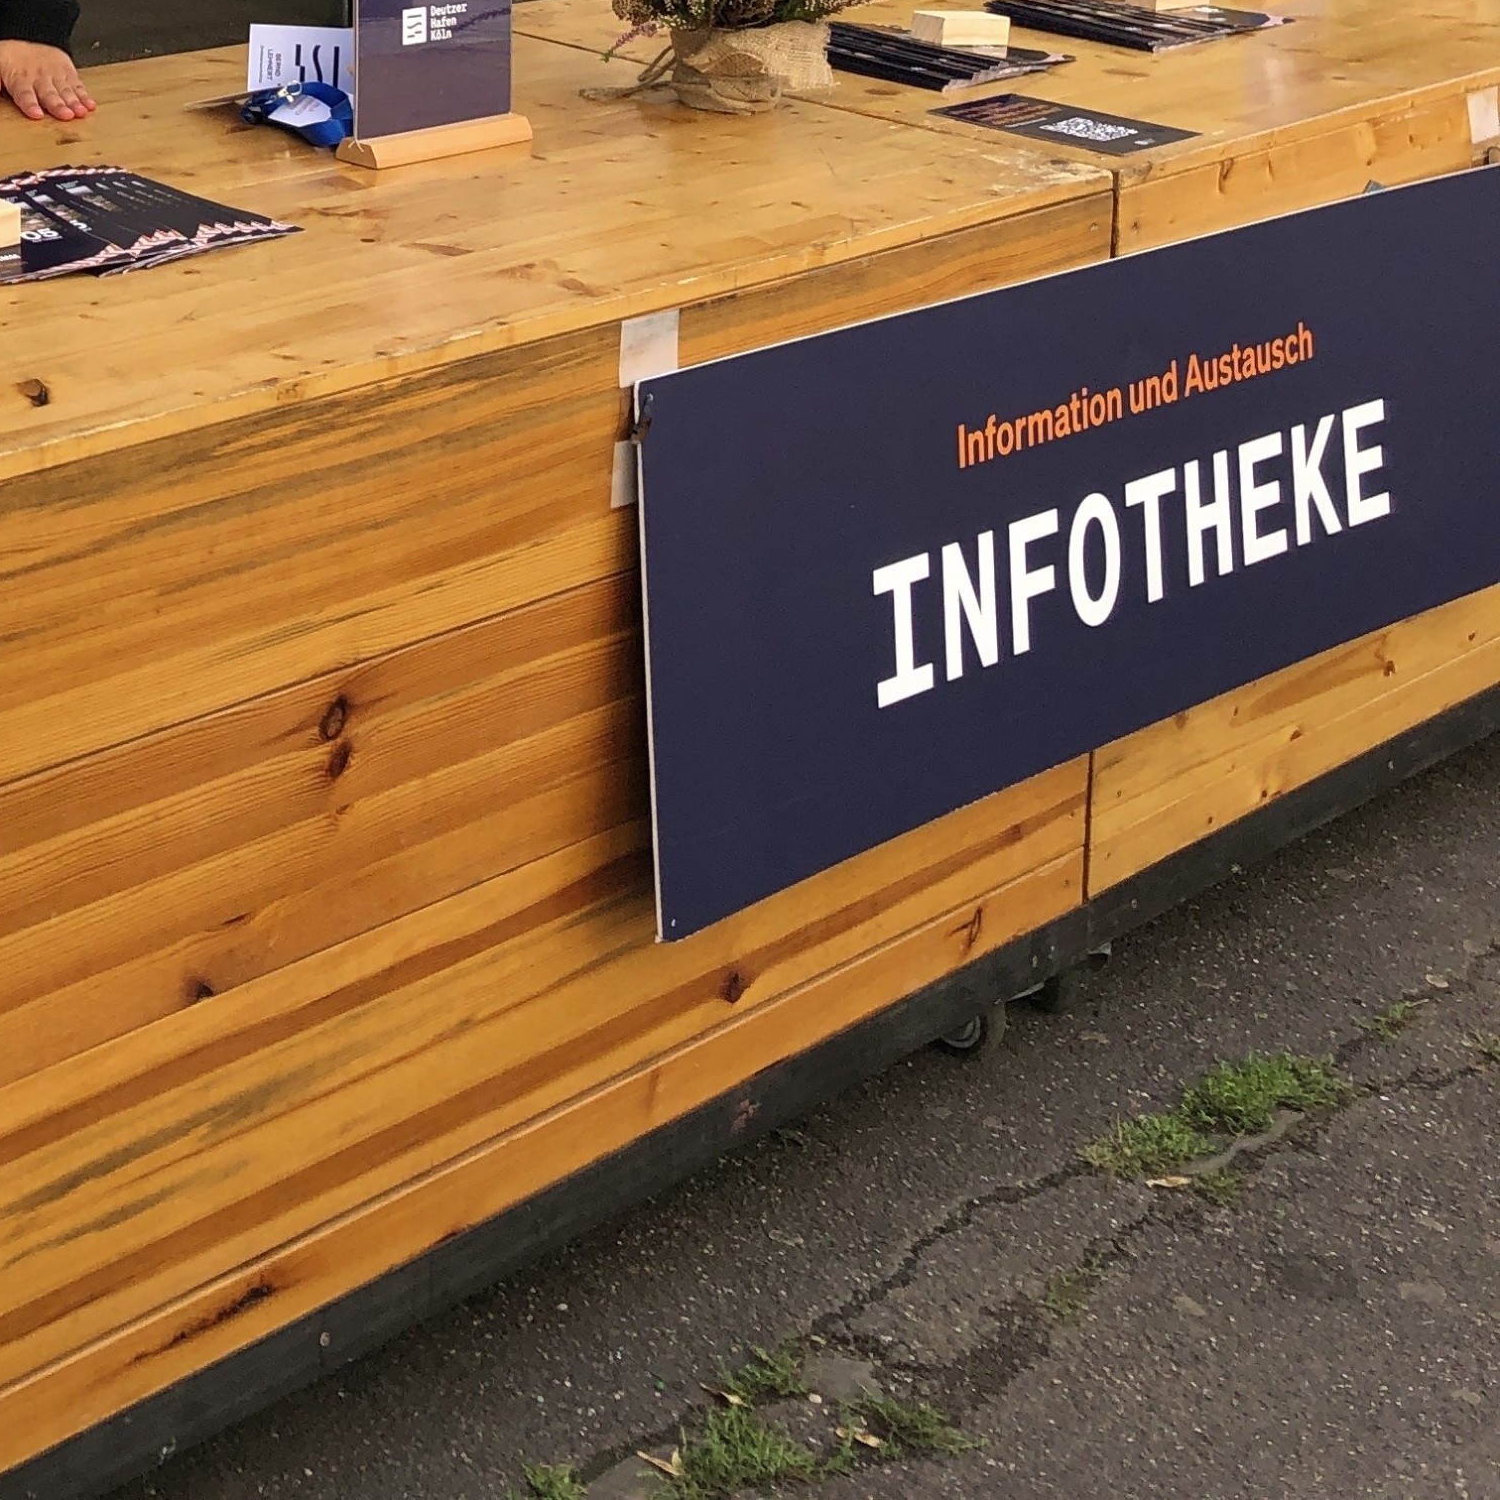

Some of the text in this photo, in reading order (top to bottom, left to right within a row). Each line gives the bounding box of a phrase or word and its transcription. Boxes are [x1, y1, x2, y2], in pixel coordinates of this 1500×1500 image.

[430, 2, 467, 16] Deutzer
[430, 16, 457, 29] Hafen
[430, 28, 453, 41] Köln
[20, 227, 59, 241] 05
[957, 322, 1314, 469] Information und Austausch
[873, 398, 1391, 709] INFOTHEKE
